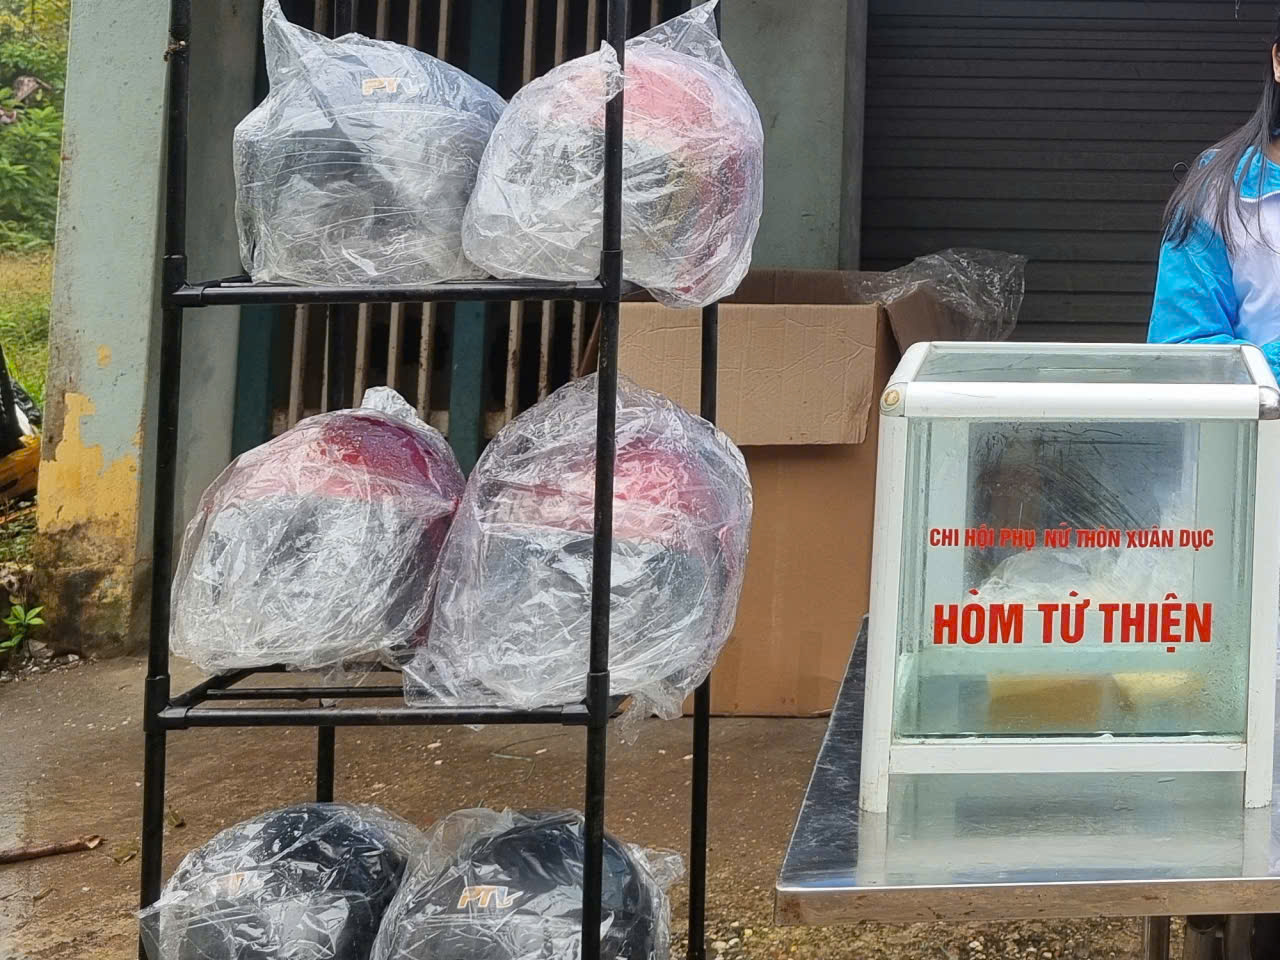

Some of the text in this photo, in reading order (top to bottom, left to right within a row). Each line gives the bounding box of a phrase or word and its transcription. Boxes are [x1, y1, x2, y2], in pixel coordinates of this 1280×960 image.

[930, 528, 959, 546] CHI
[965, 524, 995, 550] HỘI
[999, 528, 1036, 550] PHỤ
[1076, 526, 1121, 548] THÔN
[1126, 527, 1174, 547] XUÂN
[1180, 529, 1214, 549] DỤC
[934, 589, 1212, 652] HÒM TỪ THIỆN
